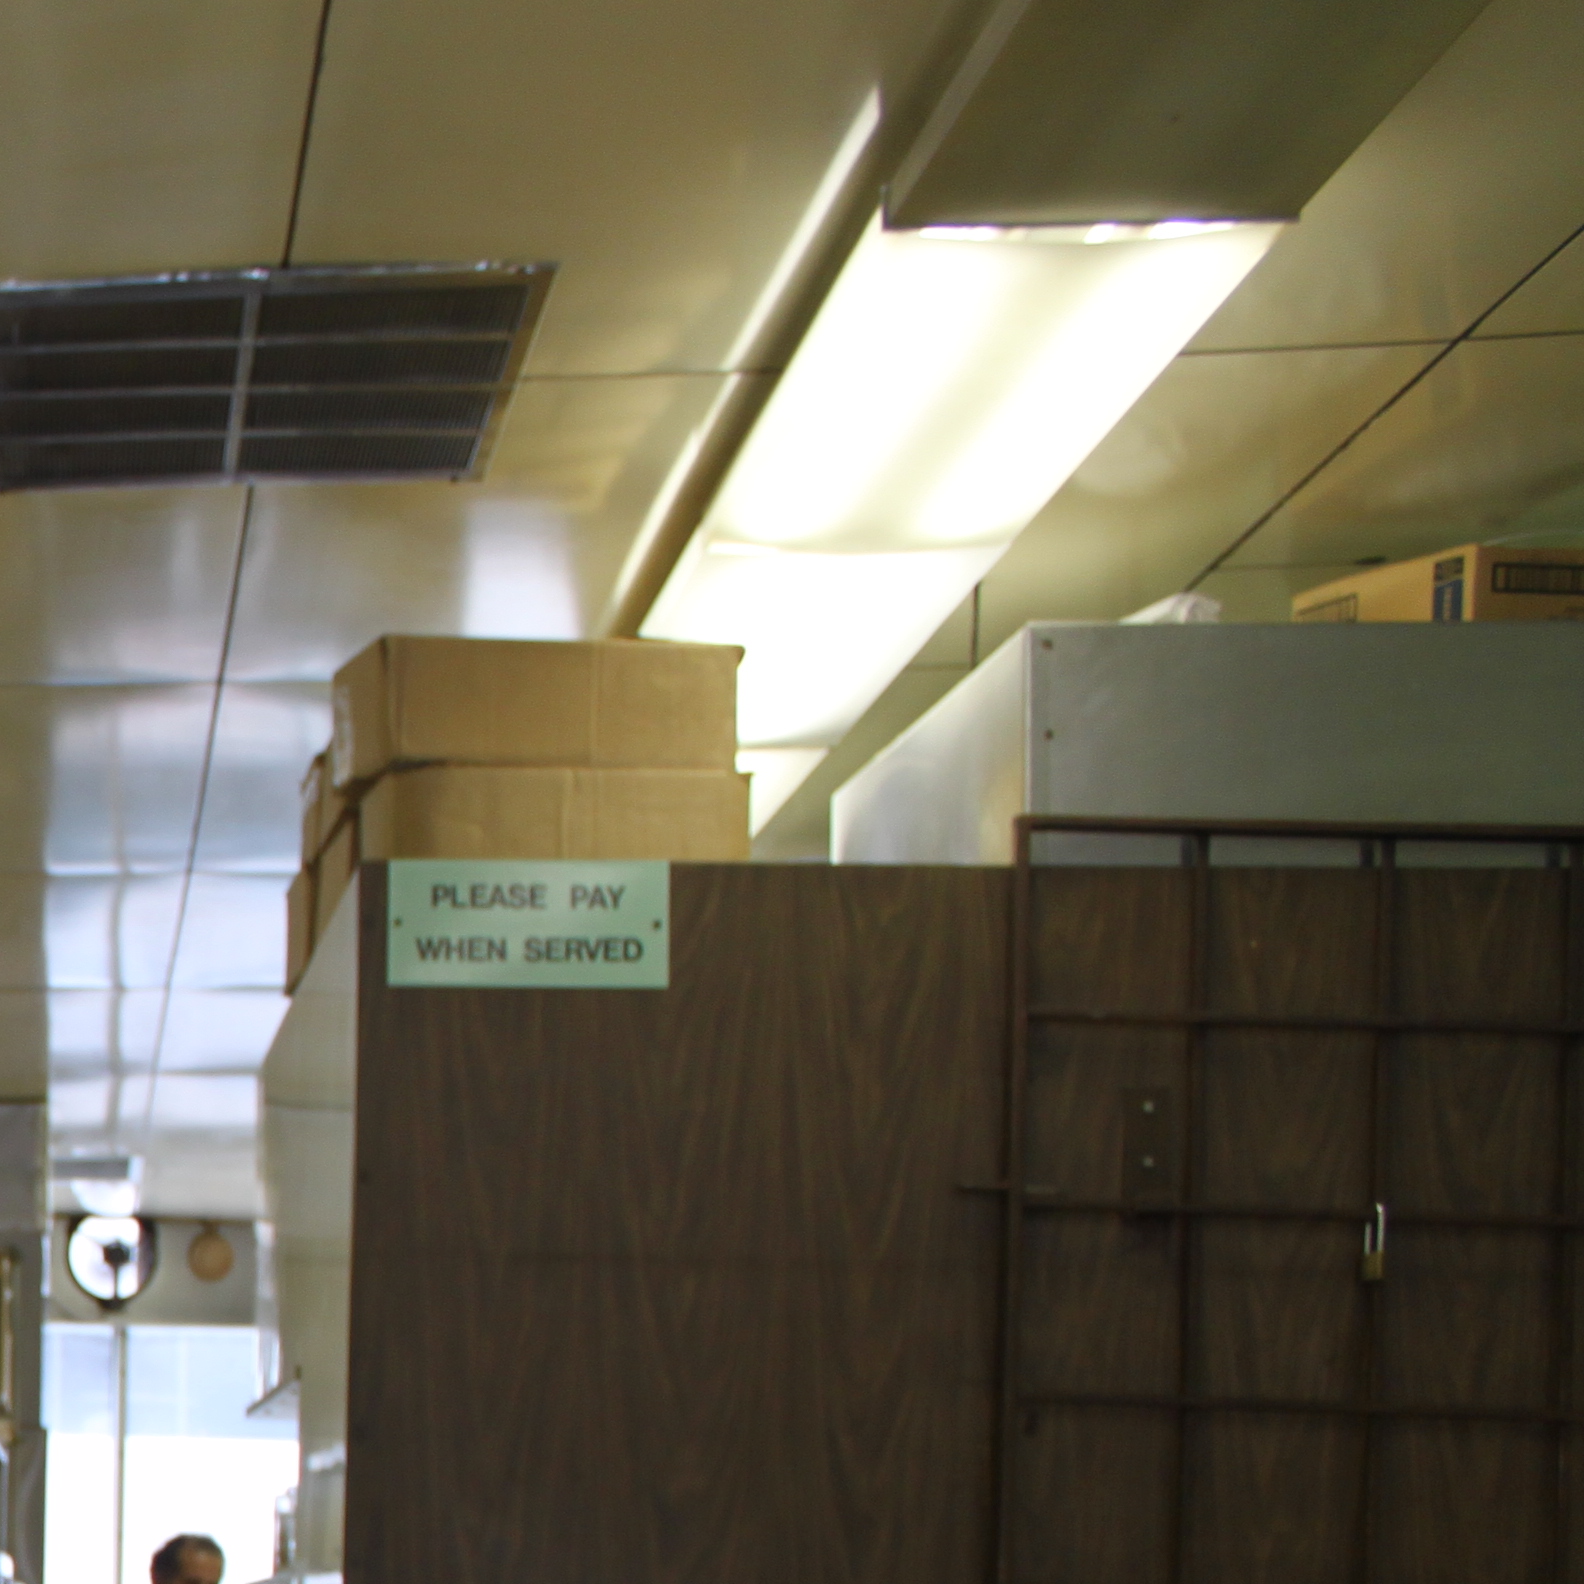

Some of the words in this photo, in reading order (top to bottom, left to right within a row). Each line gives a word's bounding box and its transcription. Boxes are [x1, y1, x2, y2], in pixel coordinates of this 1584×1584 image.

[431, 883, 548, 910] PLEASE
[570, 883, 626, 910] PAY
[415, 936, 509, 963] WHEN
[523, 936, 644, 963] SERVED
